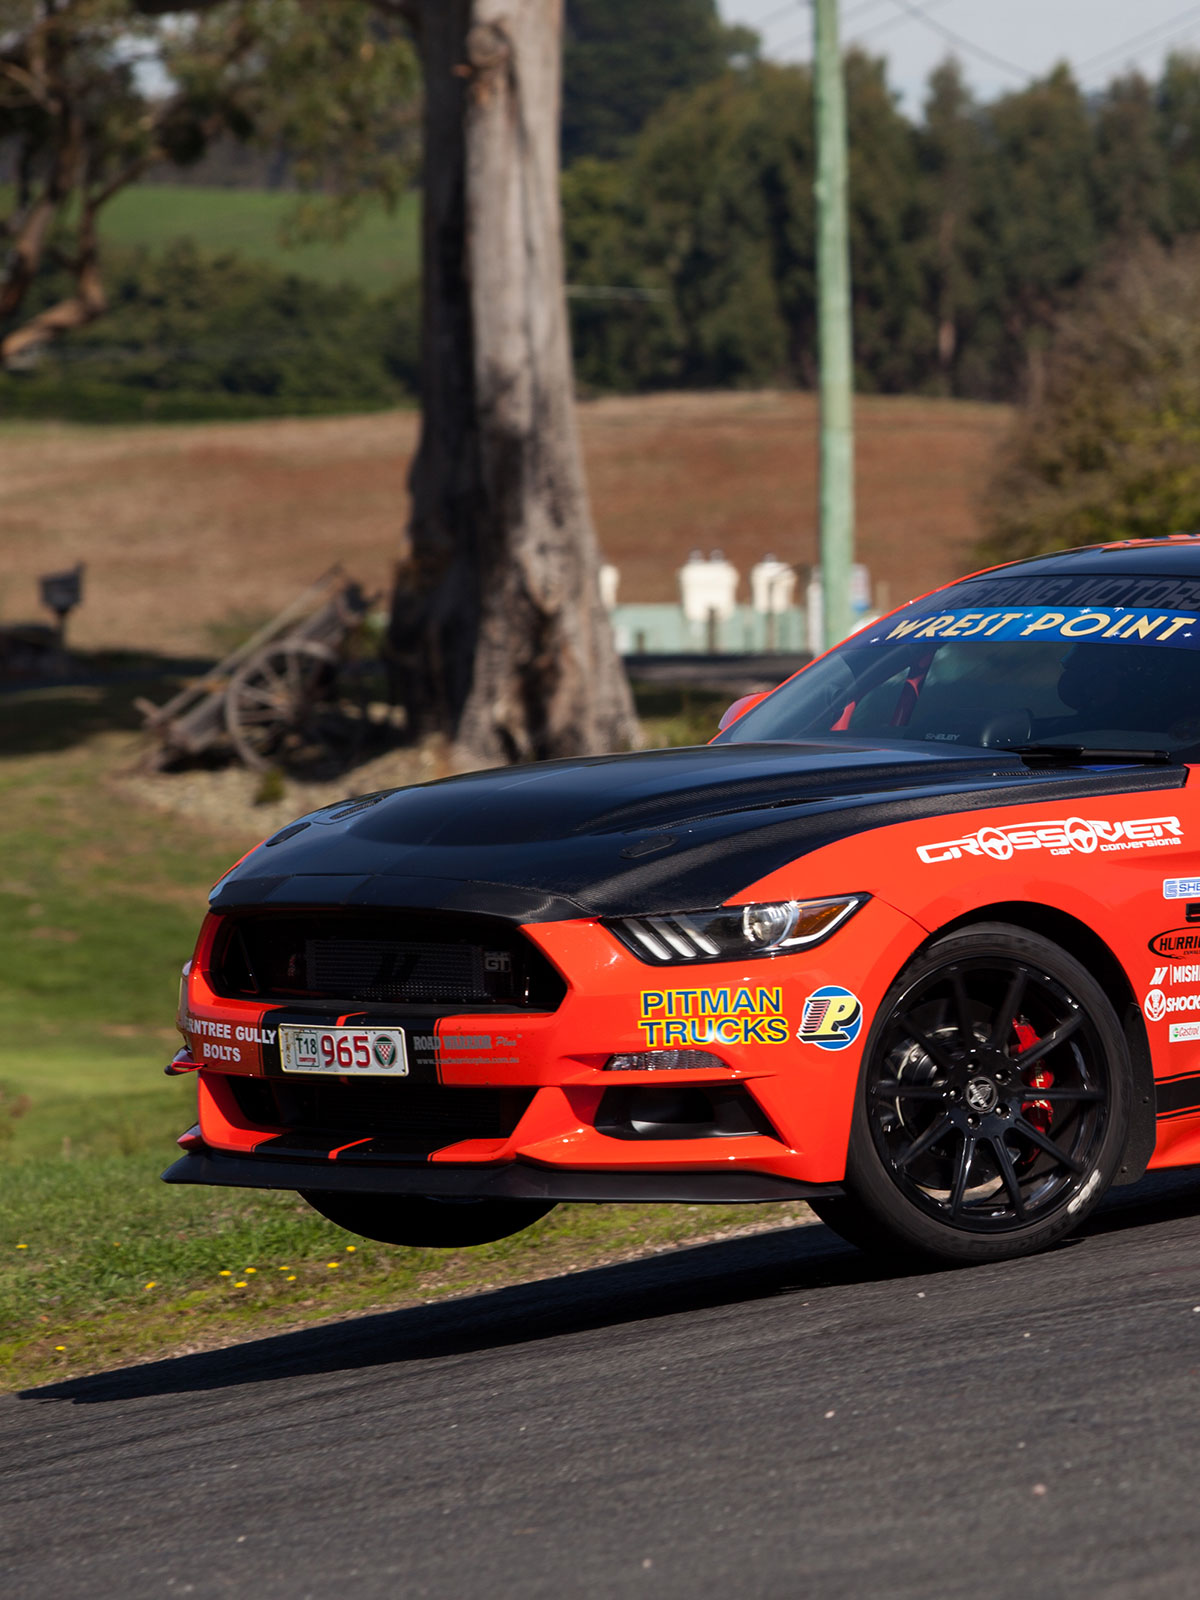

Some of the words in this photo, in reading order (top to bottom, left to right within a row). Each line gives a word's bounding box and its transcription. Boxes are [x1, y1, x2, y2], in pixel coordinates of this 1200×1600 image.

[885, 613, 1024, 640] WREST
[1019, 613, 1197, 641] POINT
[1050, 847, 1074, 856] car
[1100, 837, 1181, 852] conversions
[640, 987, 782, 1018] PITMAN
[235, 1026, 276, 1045] GULLY
[638, 1016, 790, 1047] TRUCKS
[203, 1043, 241, 1062] BOLTS
[295, 1037, 317, 1055] T18
[321, 1034, 371, 1068] 965
[413, 1036, 442, 1051] ROAD
